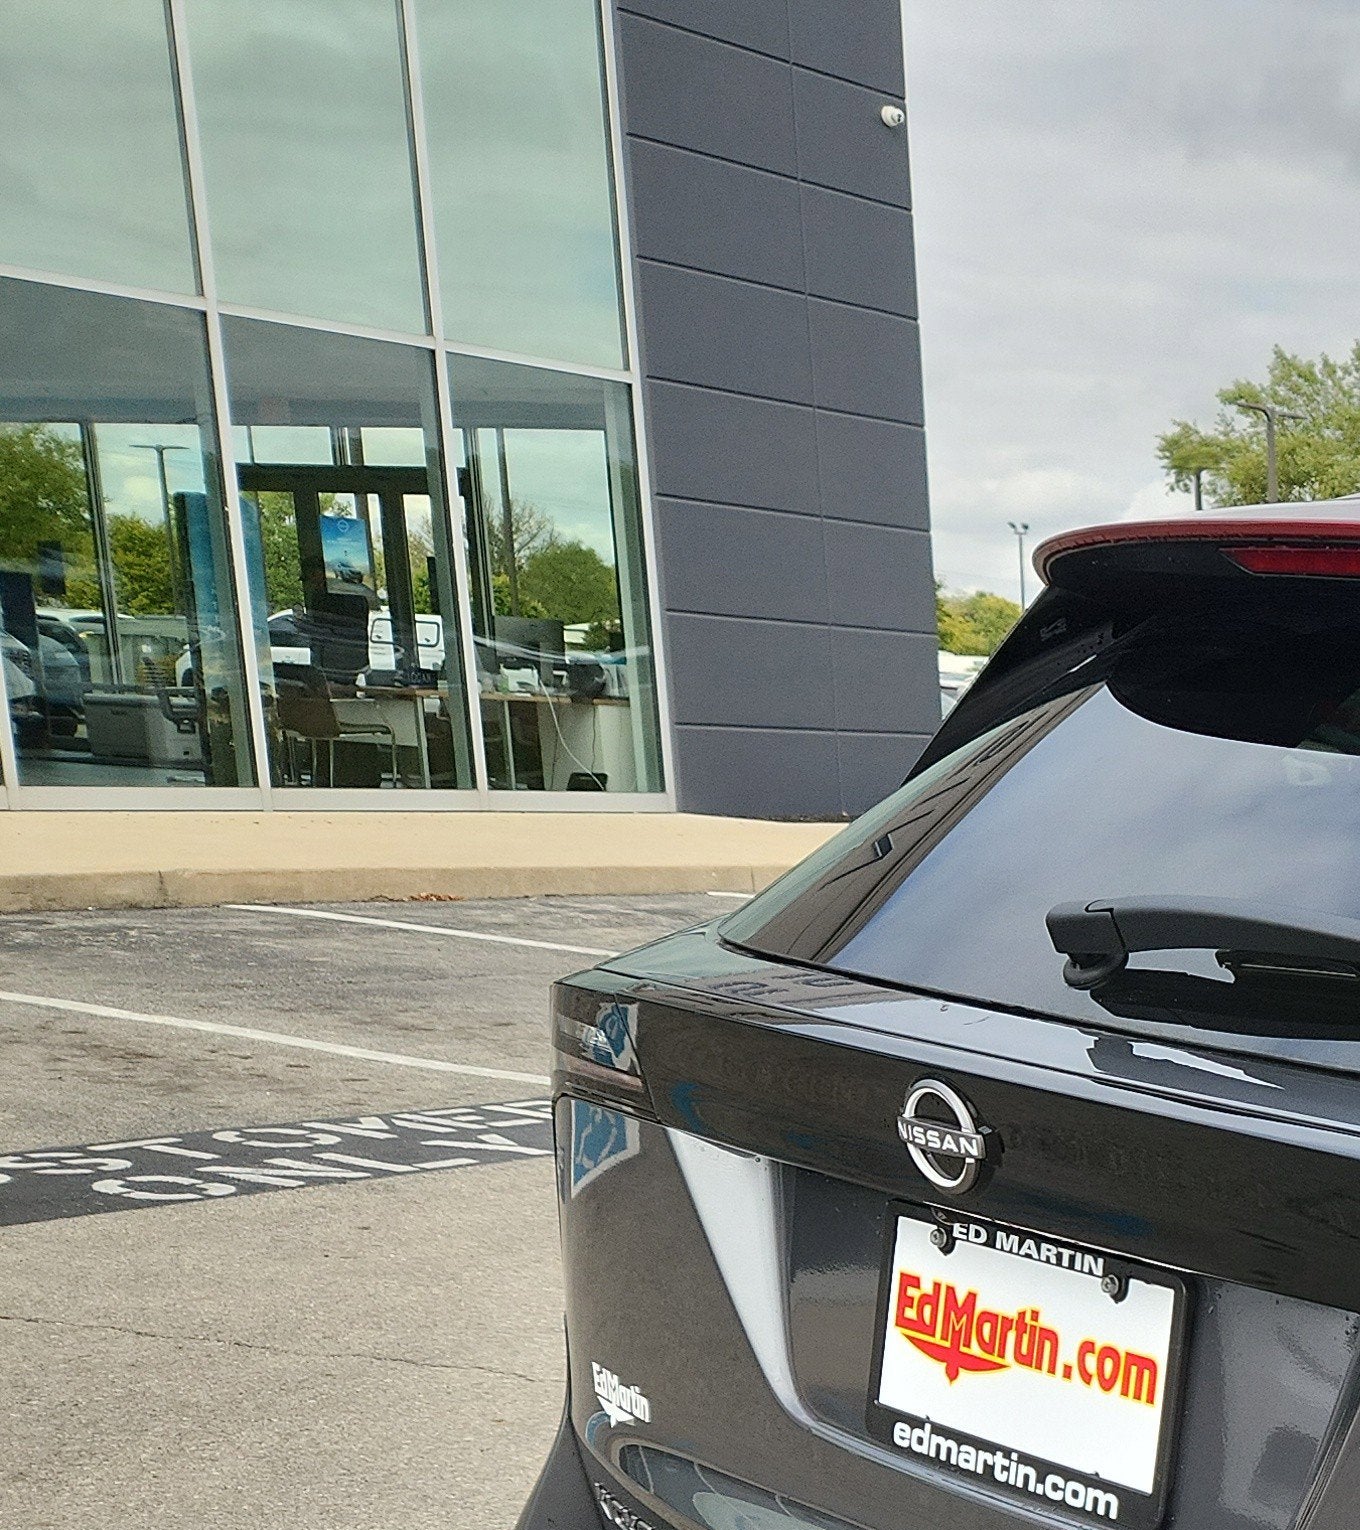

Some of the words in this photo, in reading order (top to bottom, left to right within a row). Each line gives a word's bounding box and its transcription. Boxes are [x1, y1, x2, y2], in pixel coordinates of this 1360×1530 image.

[92, 1133, 553, 1203] ONLY
[898, 1118, 979, 1157] NISSAN
[952, 1223, 988, 1244] ED
[995, 1231, 1105, 1277] MARTIN
[892, 1421, 1120, 1521] edmartin.com
